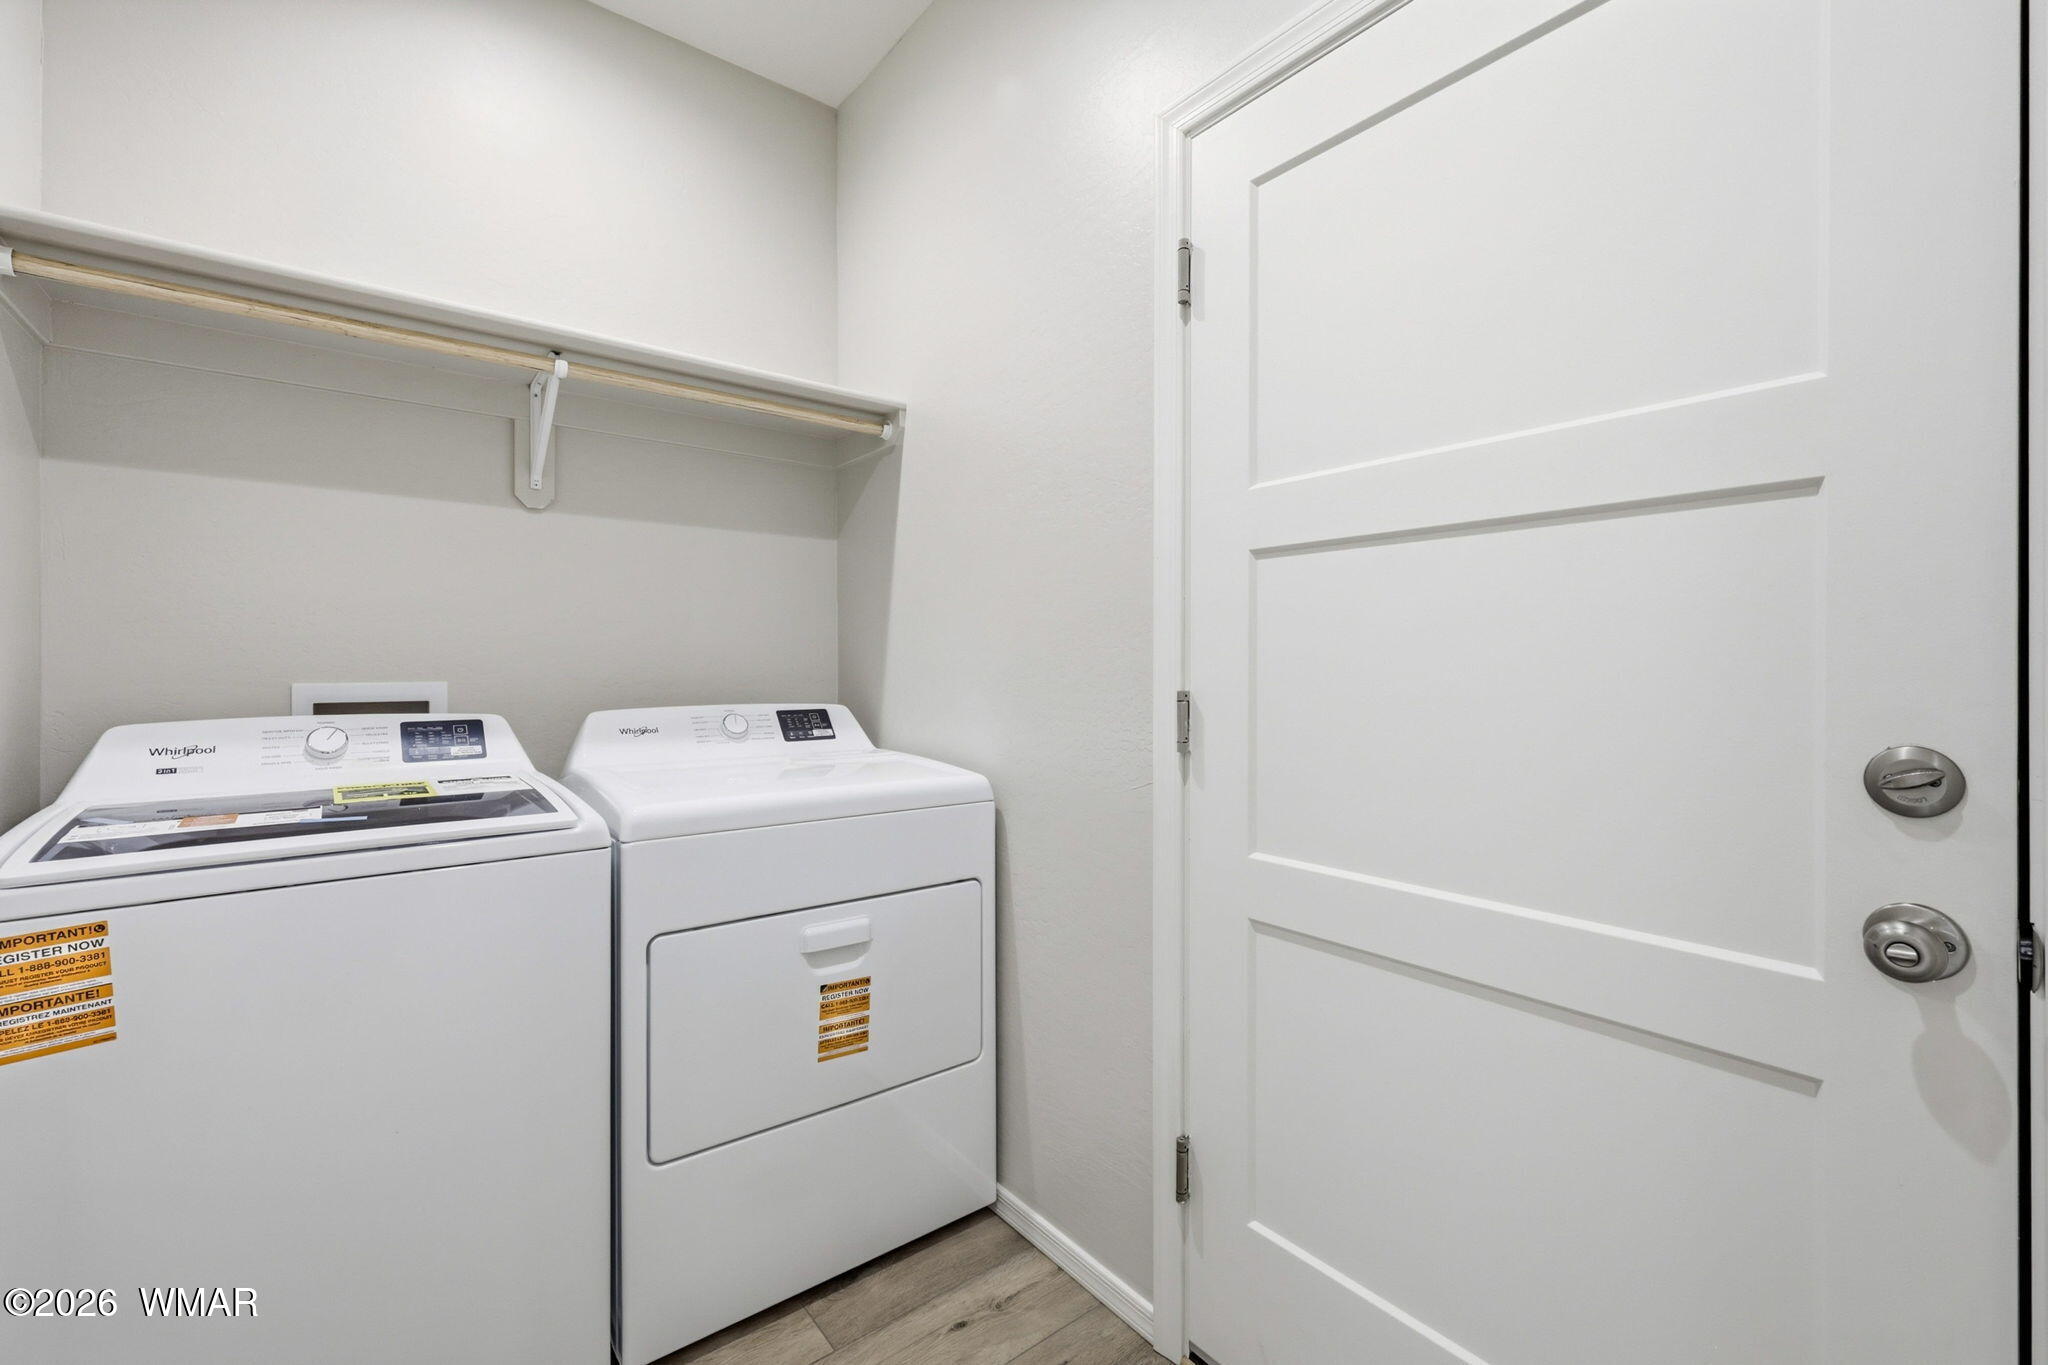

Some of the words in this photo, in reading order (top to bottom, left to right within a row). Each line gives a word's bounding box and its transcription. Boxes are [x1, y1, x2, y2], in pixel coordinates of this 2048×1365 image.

[619, 726, 659, 737] Whirlpool
[149, 745, 216, 759] Whirlpool
[0, 926, 92, 949] MPORTANT!
[0, 946, 62, 965] GISTER
[68, 938, 105, 953] NOW
[19, 952, 106, 973] 1-888-900-3381
[855, 987, 869, 995] NOW
[0, 989, 100, 1016] MPORTANTE!
[0, 1011, 50, 1027] EGISTREZ
[53, 998, 112, 1016] MAINTENANT
[0, 1024, 29, 1035] PELEZ
[32, 1021, 43, 1030] LE
